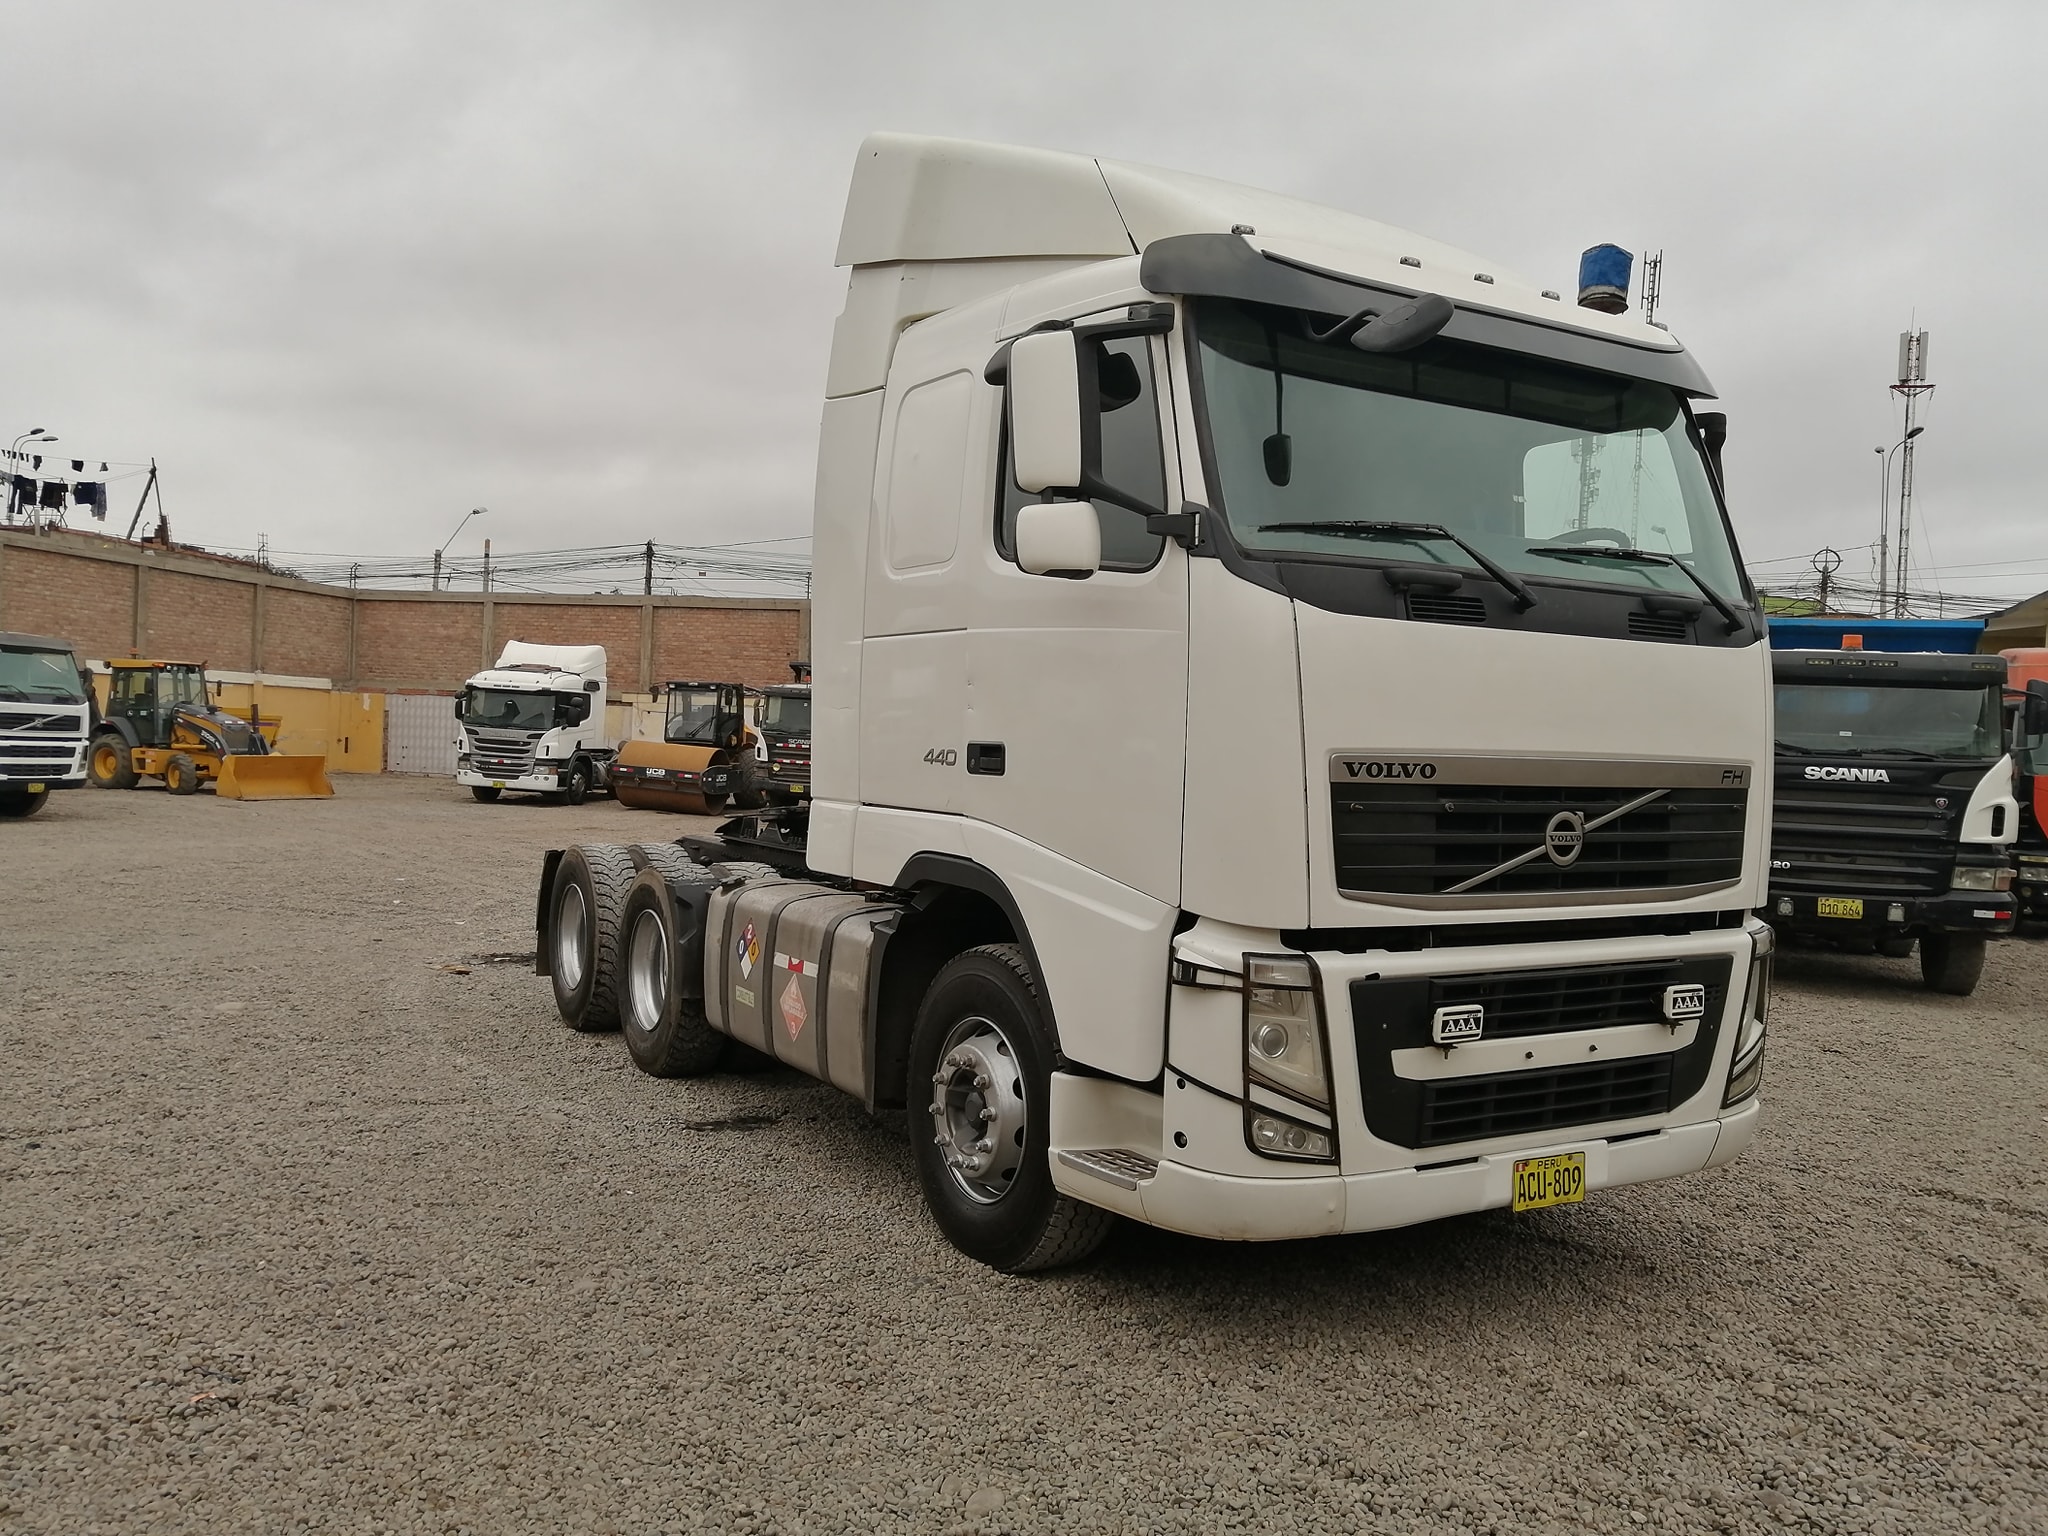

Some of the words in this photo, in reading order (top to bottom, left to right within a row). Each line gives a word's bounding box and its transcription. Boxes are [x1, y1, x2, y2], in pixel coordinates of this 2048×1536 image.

[923, 748, 957, 767] 440
[646, 768, 666, 776] JCB
[1342, 761, 1437, 779] VOLVO
[1721, 770, 1744, 785] FH
[1804, 766, 1890, 783] SCANIA
[1548, 834, 1582, 843] VOLVO
[1769, 861, 1790, 869] 20
[747, 924, 753, 939] 2
[739, 940, 744, 954] 0
[1674, 996, 1700, 1009] AAA
[1444, 1018, 1477, 1033] AAA
[1537, 1158, 1562, 1170] PERU
[1518, 1165, 1582, 1204] ACU-809
